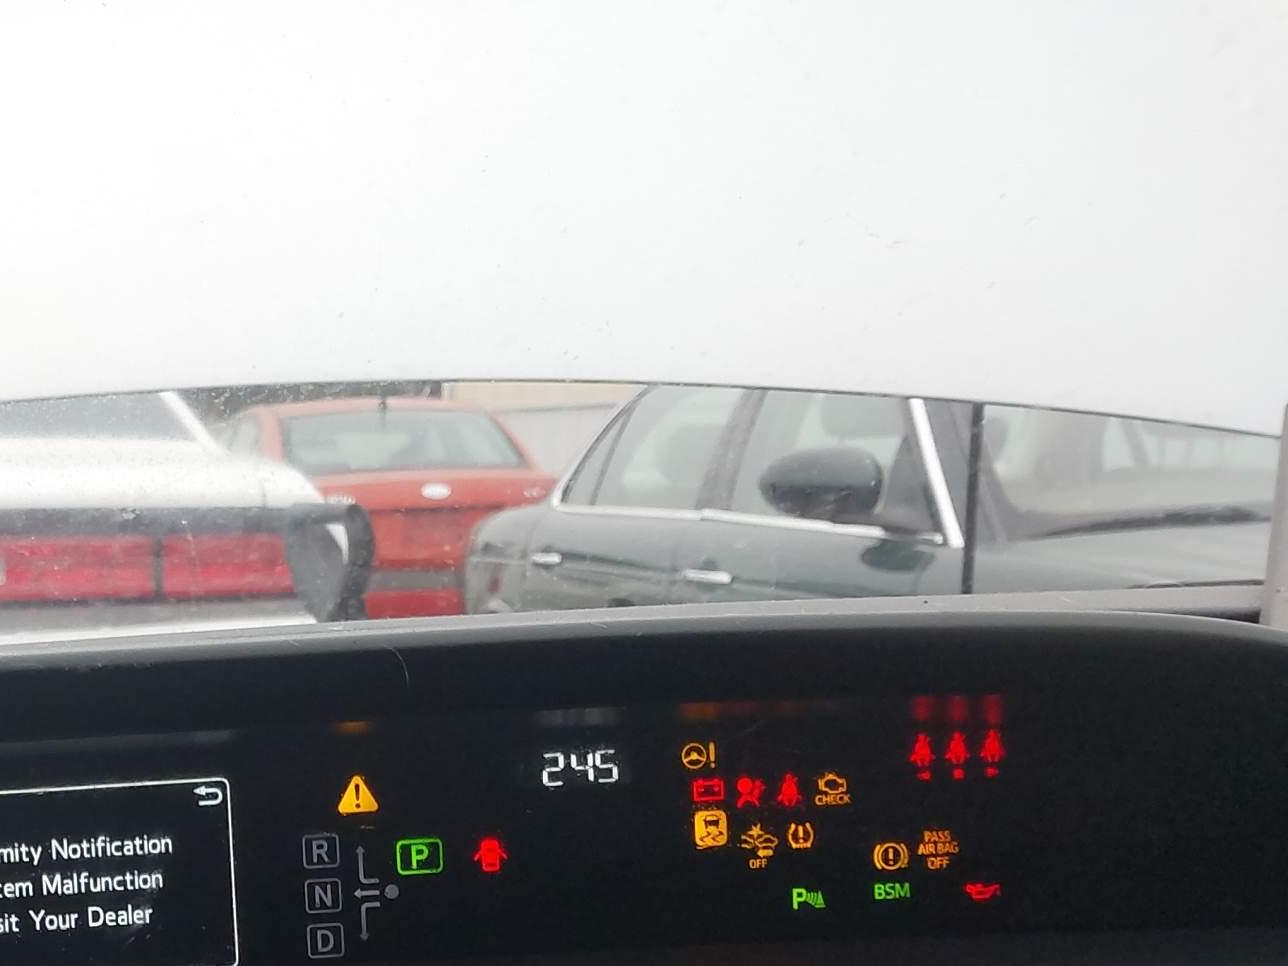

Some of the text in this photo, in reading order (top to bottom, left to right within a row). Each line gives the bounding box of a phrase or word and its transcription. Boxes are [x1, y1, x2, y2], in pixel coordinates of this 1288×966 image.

[815, 794, 851, 806] CHECK
[51, 834, 173, 858] Notification
[312, 839, 329, 863] R
[411, 845, 429, 869] P
[749, 859, 768, 869] OFF
[927, 856, 950, 870] OFF
[41, 870, 163, 896] Malfunction
[874, 883, 911, 899] BSM
[314, 884, 333, 909] N
[28, 909, 78, 932] Your
[87, 904, 153, 928] Dealer
[317, 930, 334, 952] D
